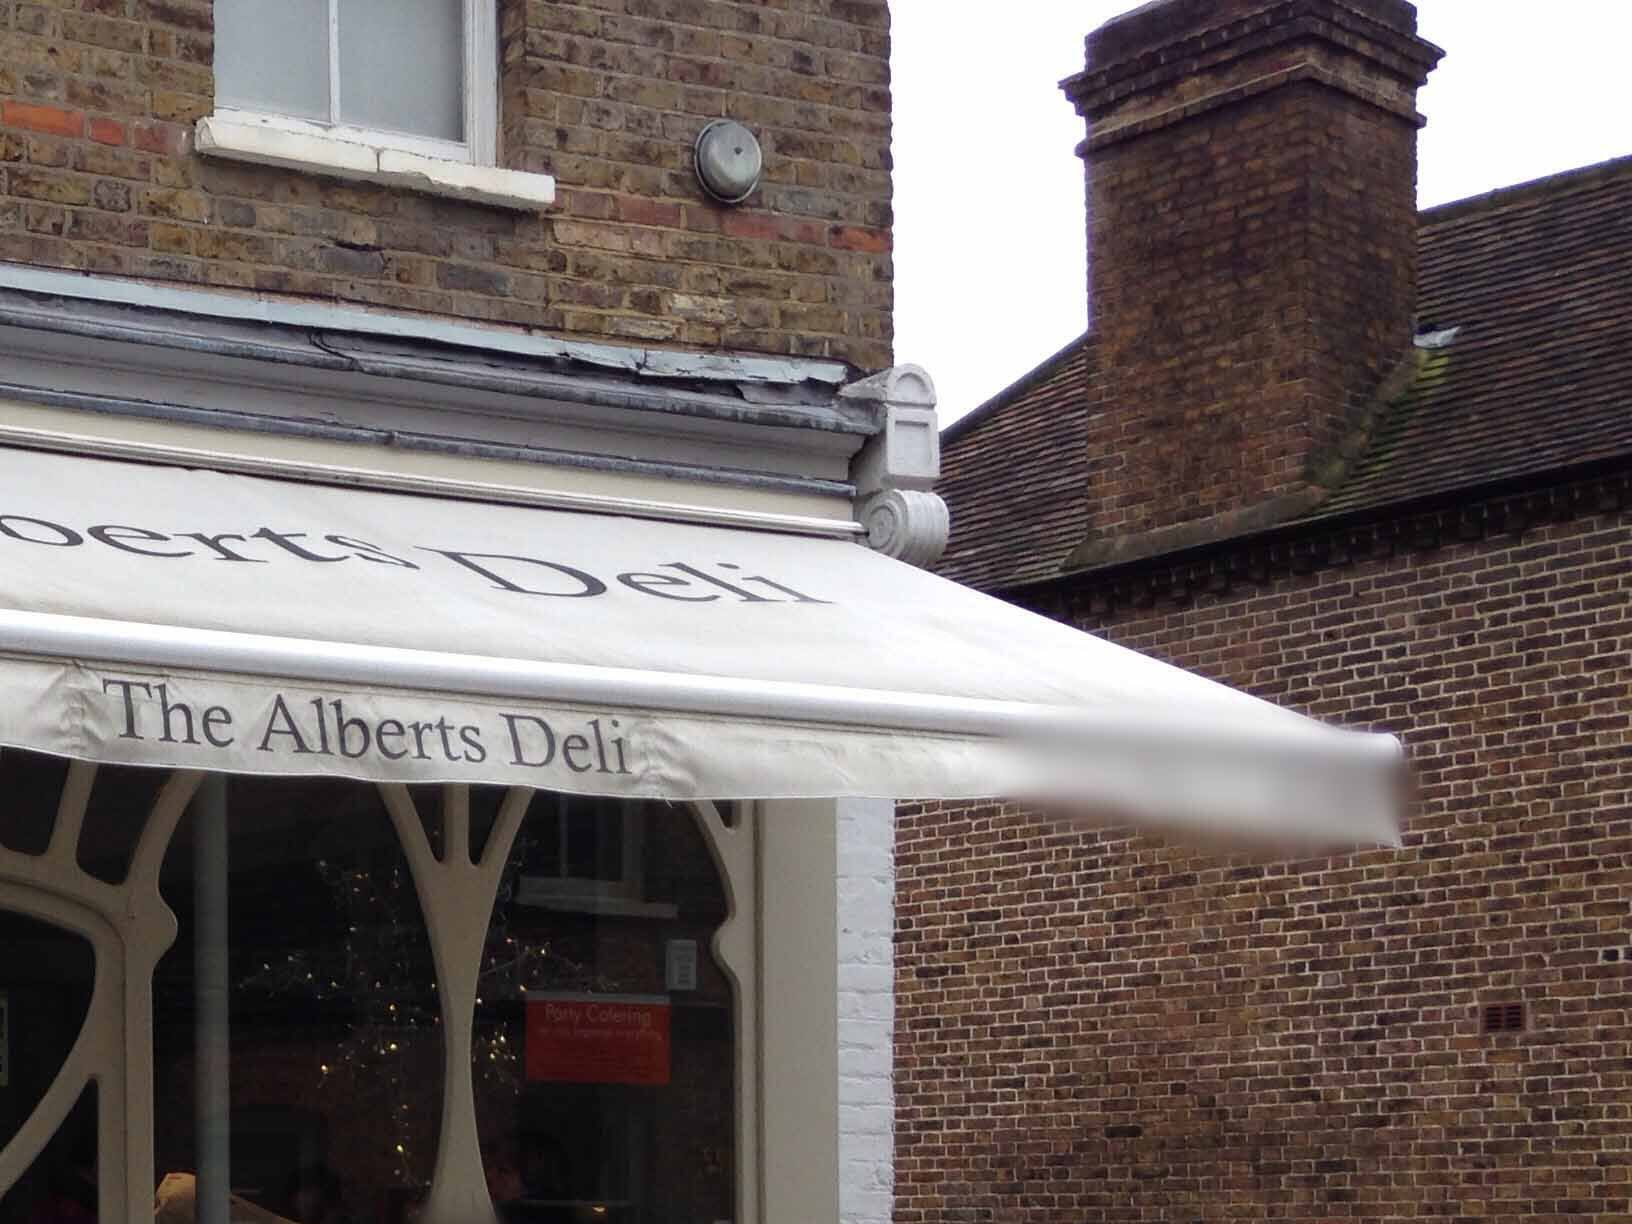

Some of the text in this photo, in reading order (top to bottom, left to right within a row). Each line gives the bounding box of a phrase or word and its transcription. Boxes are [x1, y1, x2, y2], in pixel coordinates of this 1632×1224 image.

[411, 544, 834, 605] Deli
[101, 677, 633, 775] The Alberts Deli
